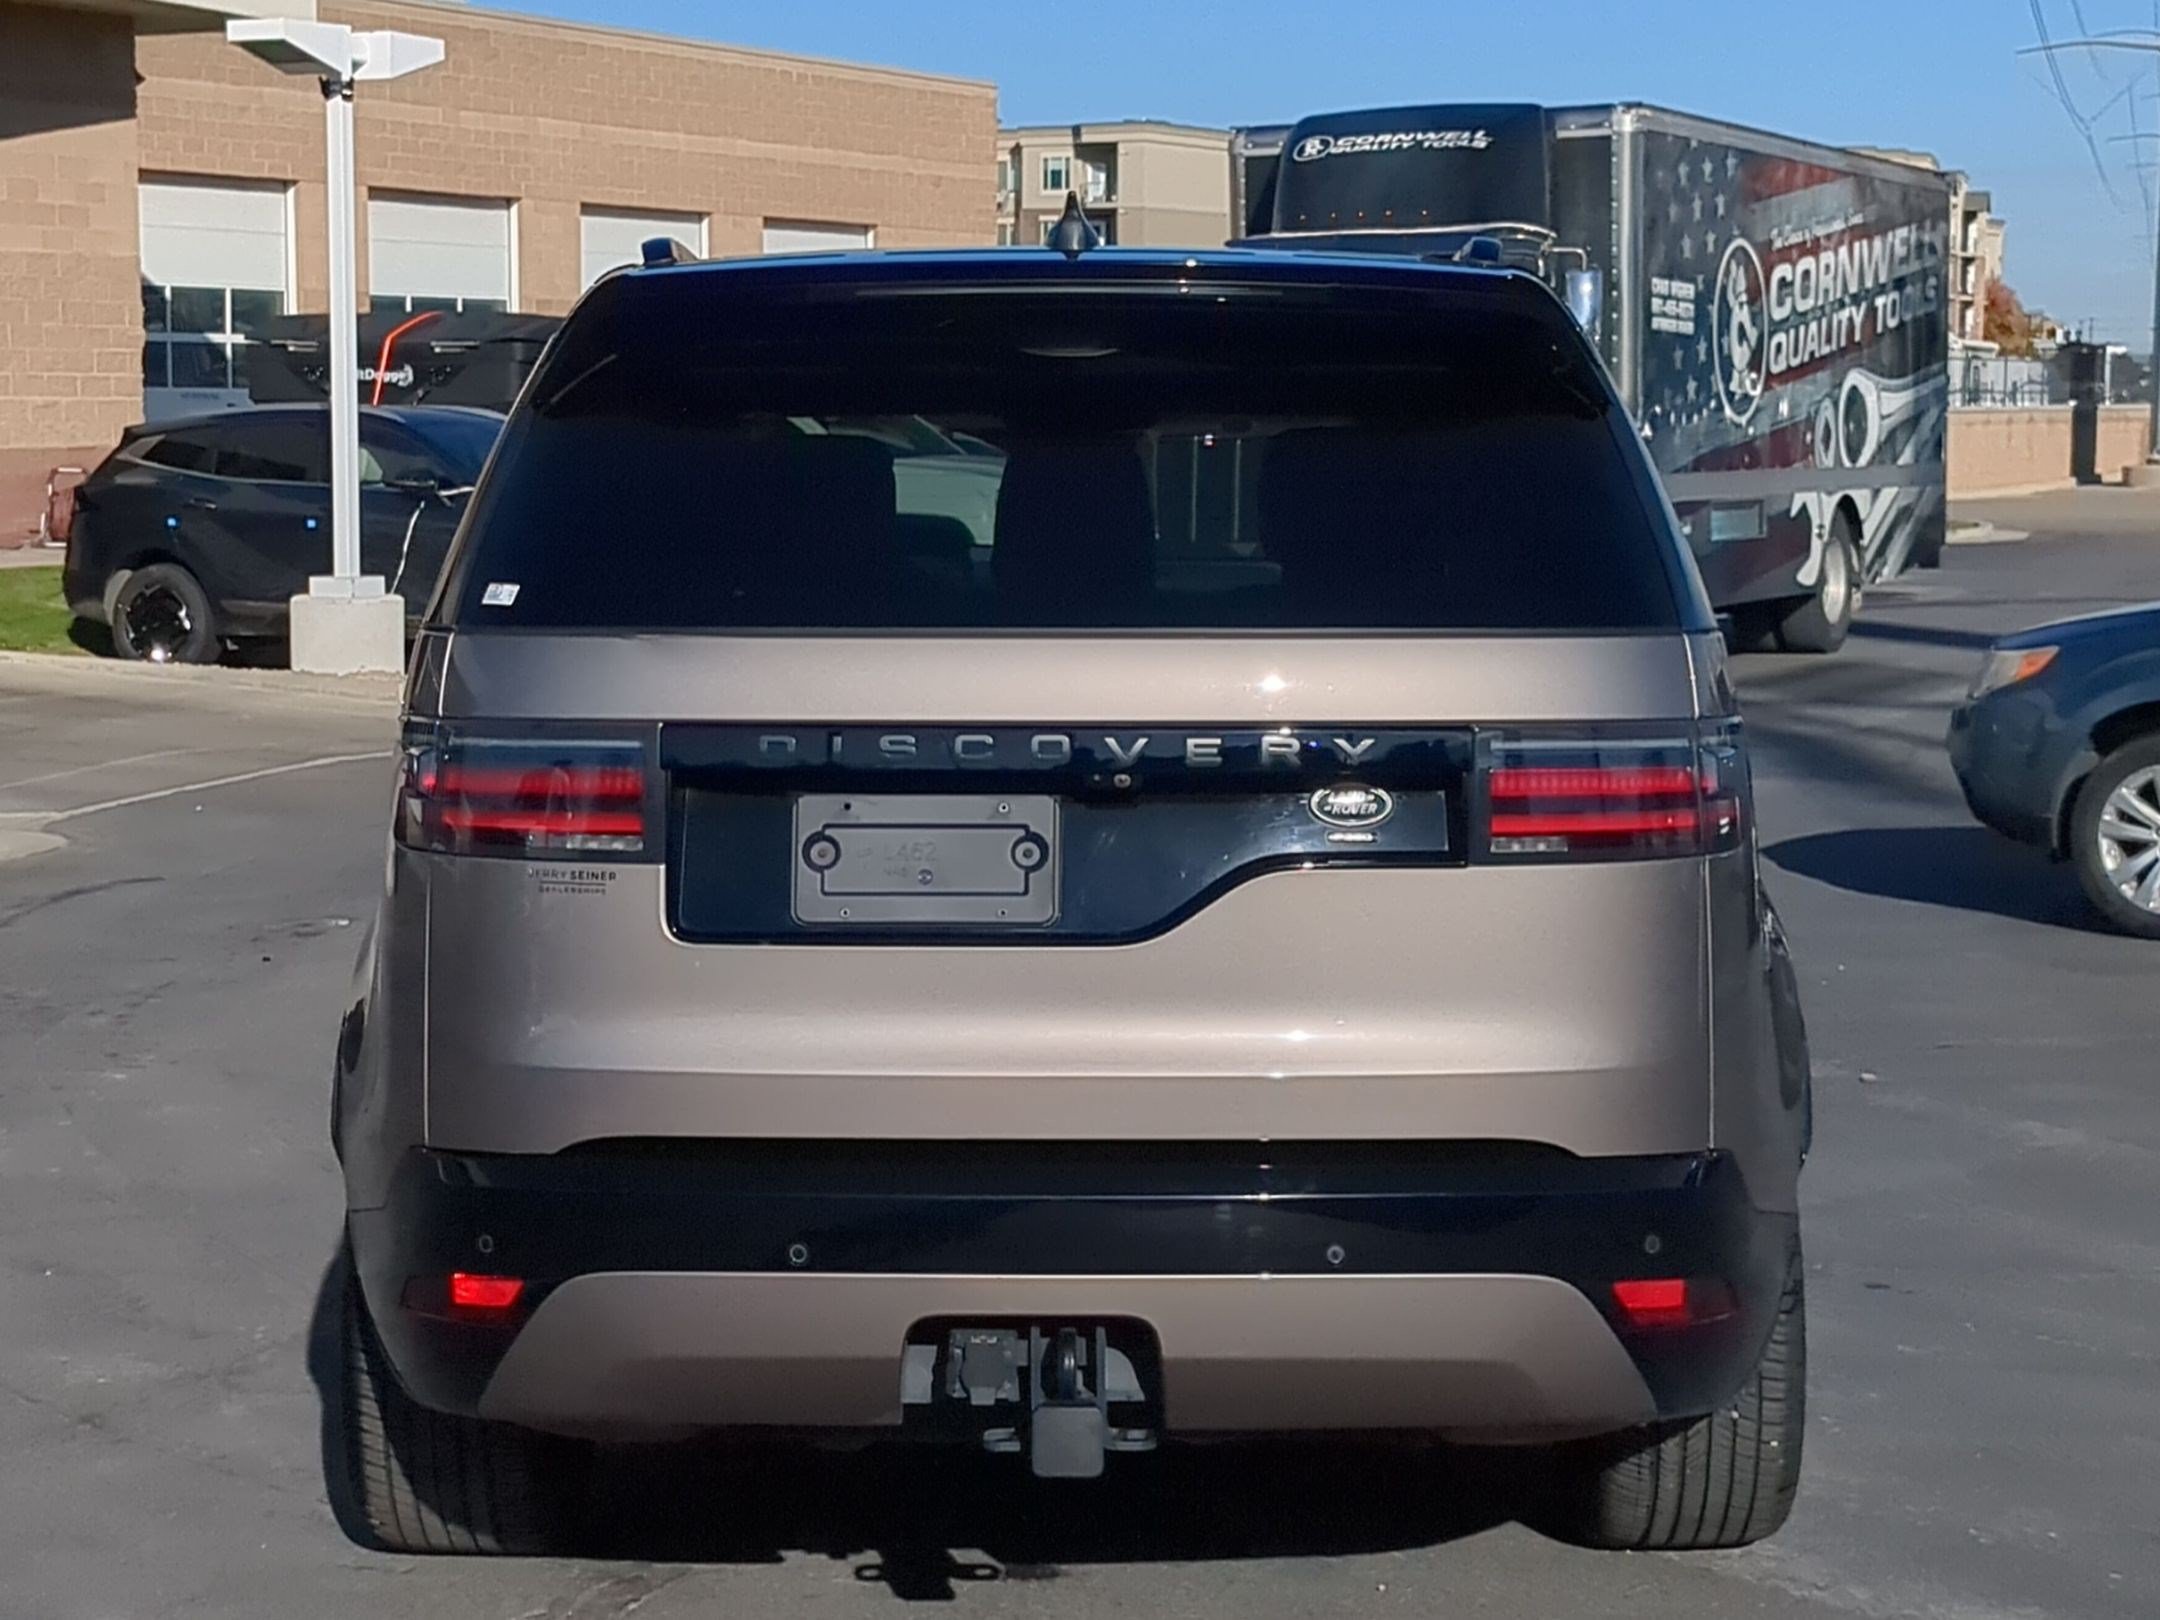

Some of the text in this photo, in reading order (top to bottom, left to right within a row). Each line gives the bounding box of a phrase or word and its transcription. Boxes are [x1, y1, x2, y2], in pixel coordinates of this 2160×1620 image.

[1336, 130, 1488, 146] CORNWELL
[1769, 301, 1867, 375] QUALITY
[759, 734, 1375, 768] DISCOVERY
[1331, 803, 1378, 815] ROVER
[570, 870, 617, 881] SEINER
